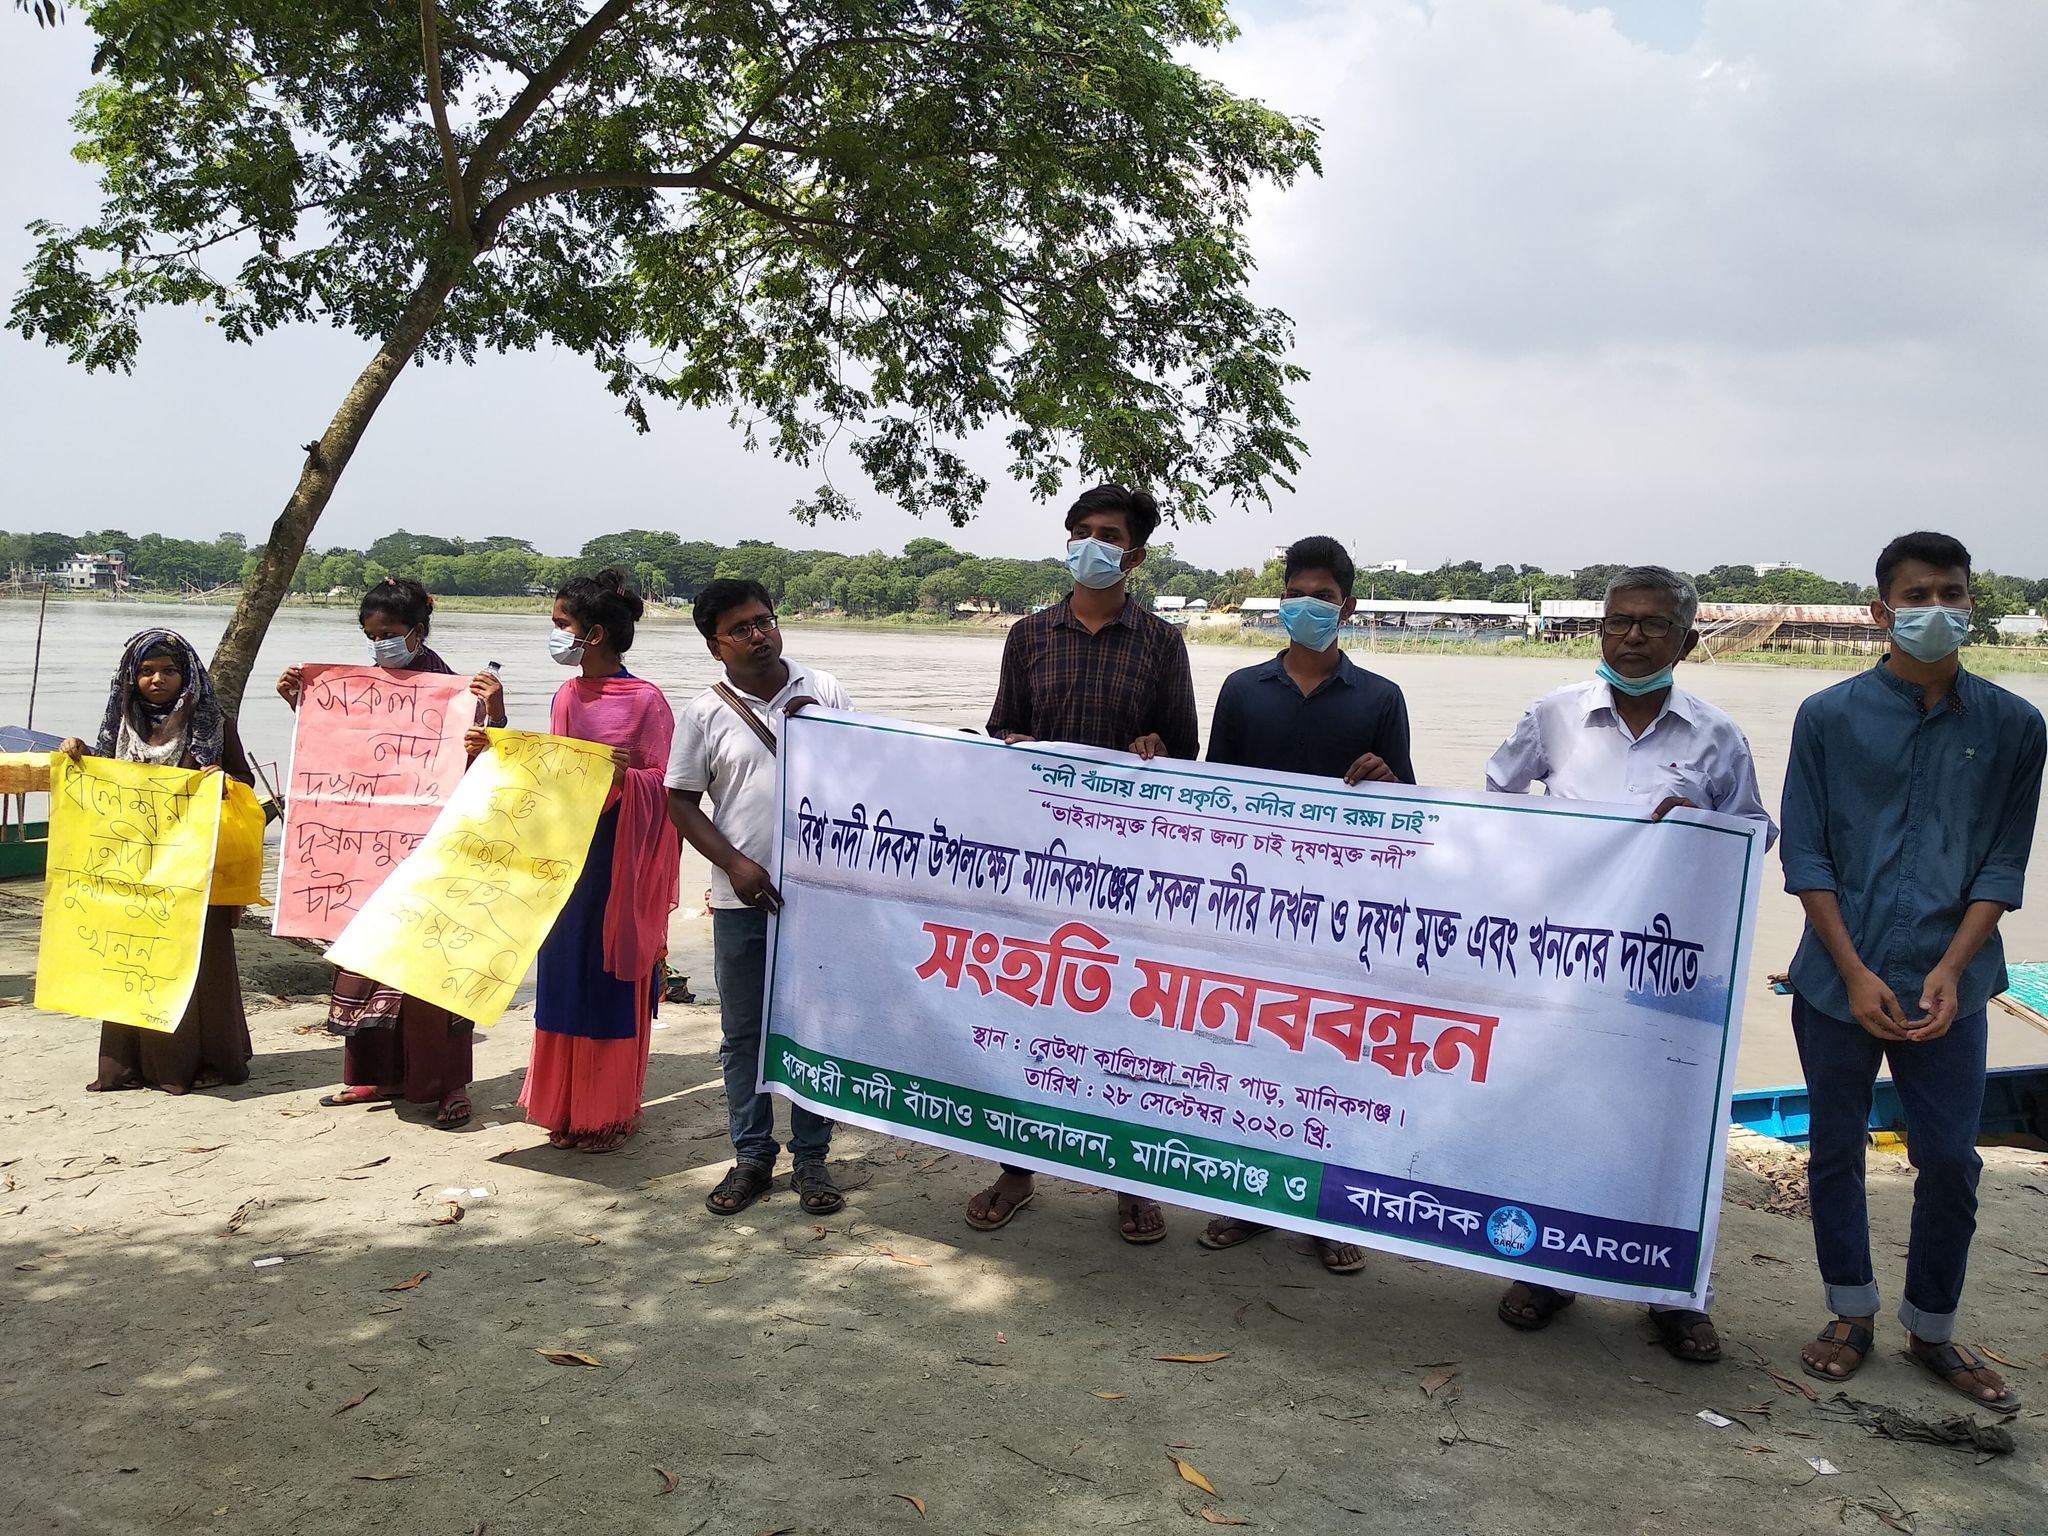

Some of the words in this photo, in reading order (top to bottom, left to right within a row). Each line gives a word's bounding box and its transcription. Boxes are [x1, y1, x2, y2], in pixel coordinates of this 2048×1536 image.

[368, 709, 453, 772] নদী
[1081, 770, 1135, 798] বাঁচায়
[1139, 783, 1174, 801] প্রাণ
[1245, 791, 1296, 818] নদীর
[1299, 803, 1338, 823] প্রাণ
[1343, 807, 1386, 828] রক্ষা
[1151, 816, 1205, 844] বিশ্বের
[1210, 828, 1248, 850] জন্য
[1253, 831, 1287, 857] চাই
[1291, 839, 1366, 868] দূষণমুক্ত
[797, 796, 828, 867] বিশ্ব
[831, 802, 869, 870] নদী
[868, 809, 924, 879] দিবস
[1023, 836, 1144, 916] মানিকগঞ্জের
[1147, 868, 1206, 925] সকল
[1208, 861, 1265, 934] নদীর
[1268, 885, 1325, 945] দখল
[1329, 899, 1347, 943] ও
[1355, 897, 1411, 974] দূষণ
[1414, 905, 1462, 976] মুক্ত
[1468, 910, 1517, 978] এবং
[1527, 915, 1614, 984] খননের
[1619, 912, 1704, 998] দাবীতে
[914, 920, 1120, 1014] সংহতি
[1128, 956, 1500, 1083] মানববন্ধন
[1028, 1034, 1089, 1066] বেউথা
[1093, 1047, 1178, 1085] কালিগঙ্গা
[1180, 1062, 1233, 1094] নদীর
[1294, 1085, 1393, 1124] মানিকগঞ্জ
[1102, 1083, 1134, 1107] ২৮
[1140, 1091, 1226, 1125] সেপ্টেম্বর
[1232, 1109, 1294, 1140] ২০২০
[781, 1049, 845, 1098] ধলেশ্বরী
[850, 1072, 897, 1111] নদী
[902, 1080, 973, 1127] বাঁচাও
[1130, 1137, 1270, 1201] মানিকগঞ্জ
[1283, 1174, 1307, 1202] ও
[1344, 1185, 1484, 1237] বারসিক
[1493, 1237, 1526, 1251] BARCIK
[1541, 1226, 1673, 1269] BARCIK
